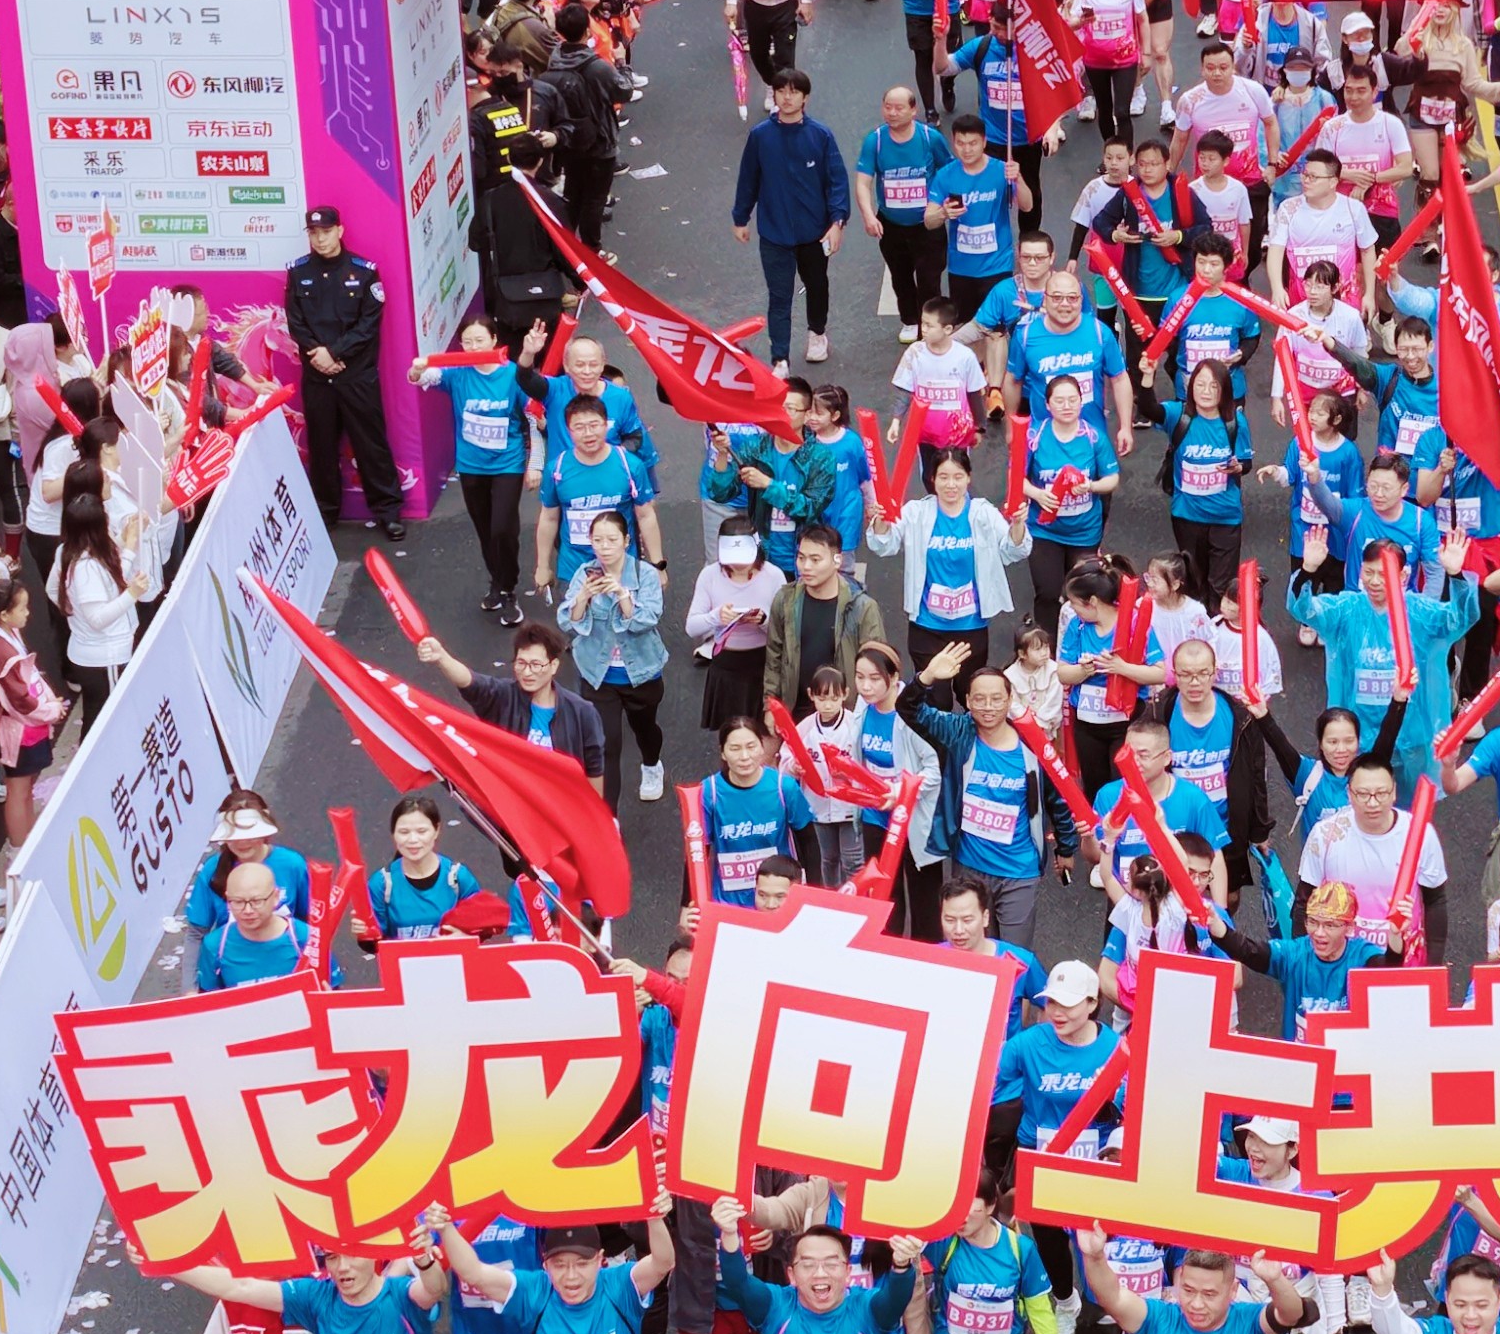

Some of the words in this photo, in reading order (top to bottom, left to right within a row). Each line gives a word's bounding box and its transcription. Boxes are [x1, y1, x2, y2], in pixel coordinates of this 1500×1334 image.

[90, 32, 222, 45] 菱势汽车
[203, 76, 284, 94] 东风柳汽
[51, 92, 87, 100] GOFIND
[187, 121, 272, 138] 京东运动
[84, 151, 123, 166] 采乐
[201, 156, 265, 172] 农夫山泉
[109, 693, 180, 853] 第一赛道
[131, 760, 196, 897] GUSTO
